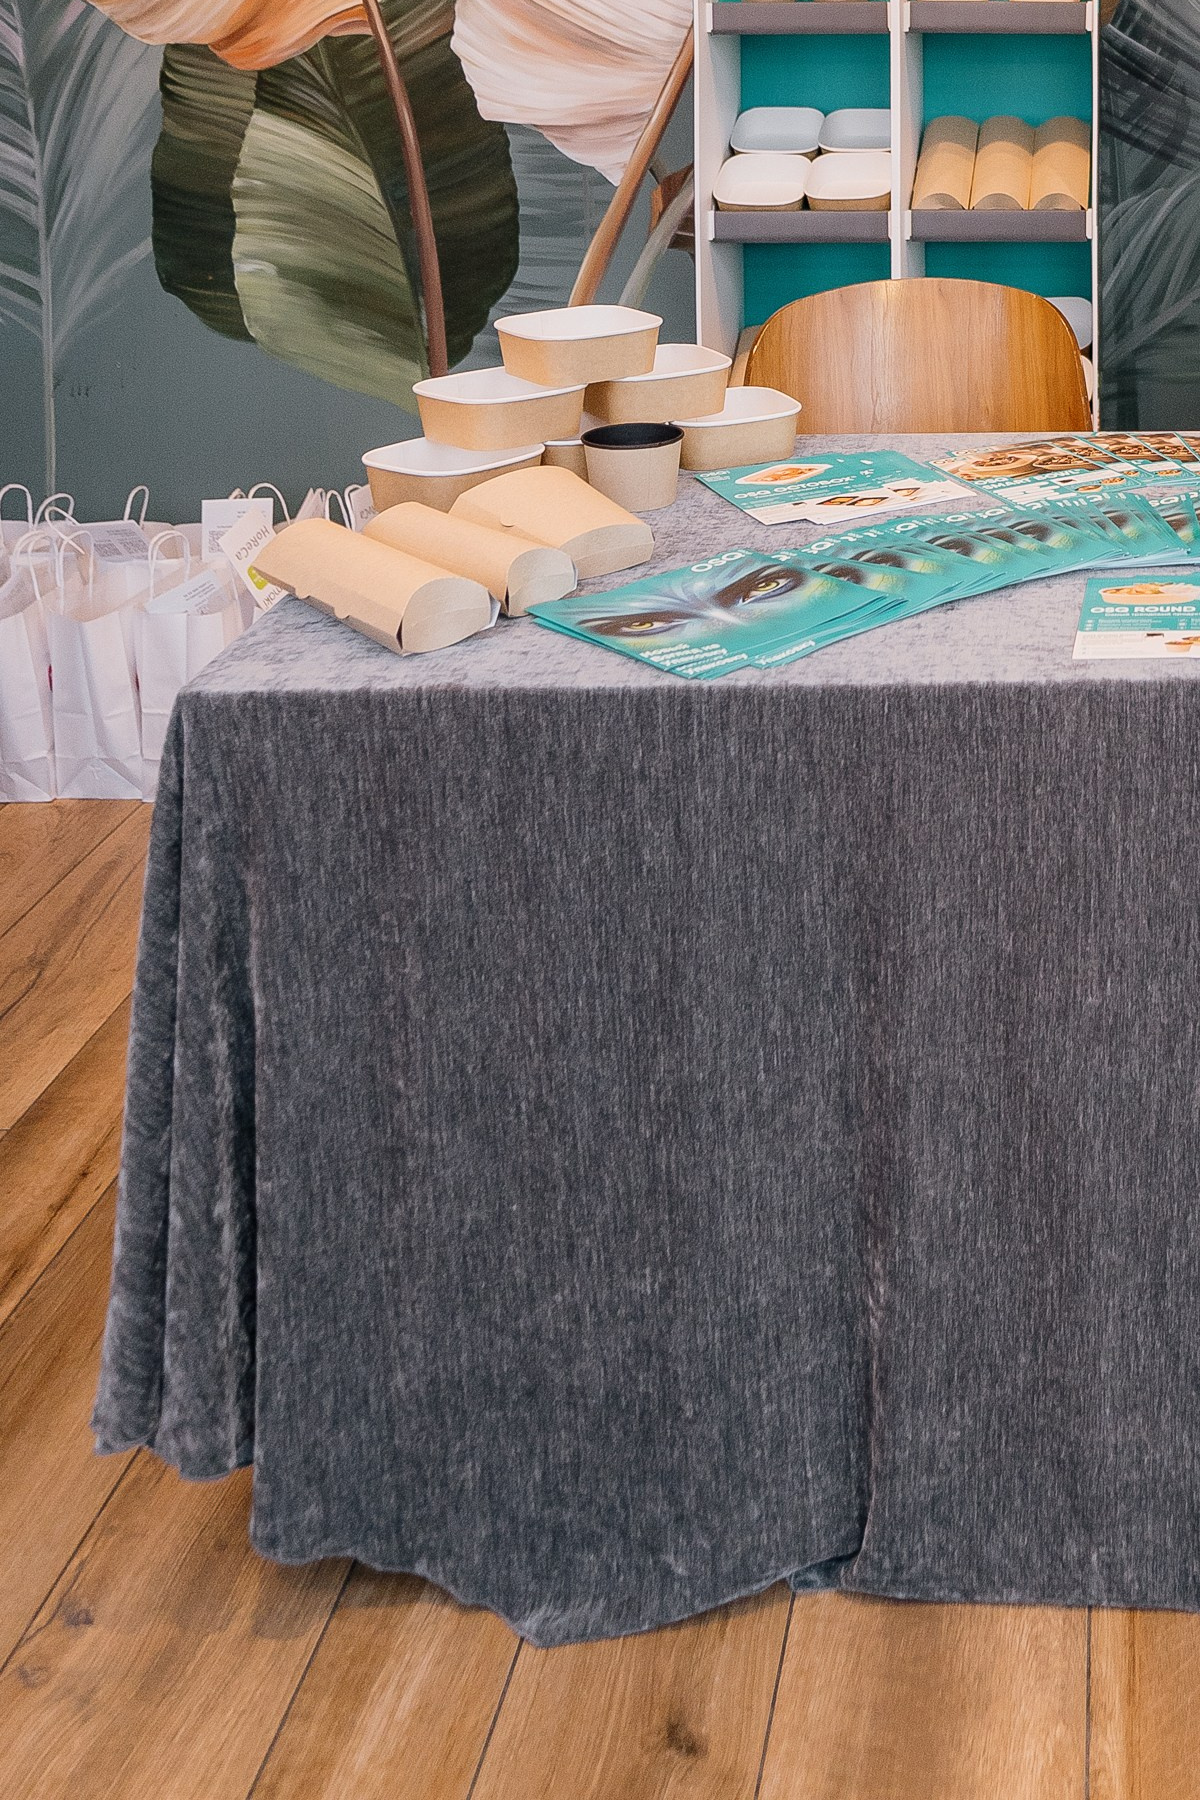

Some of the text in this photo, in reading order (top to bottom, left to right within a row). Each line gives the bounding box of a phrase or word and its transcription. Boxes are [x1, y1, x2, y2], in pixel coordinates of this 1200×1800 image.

[983, 469, 1076, 490] SMART BOWL
[235, 524, 270, 561] HoReCa
[691, 552, 746, 573] OSQ
